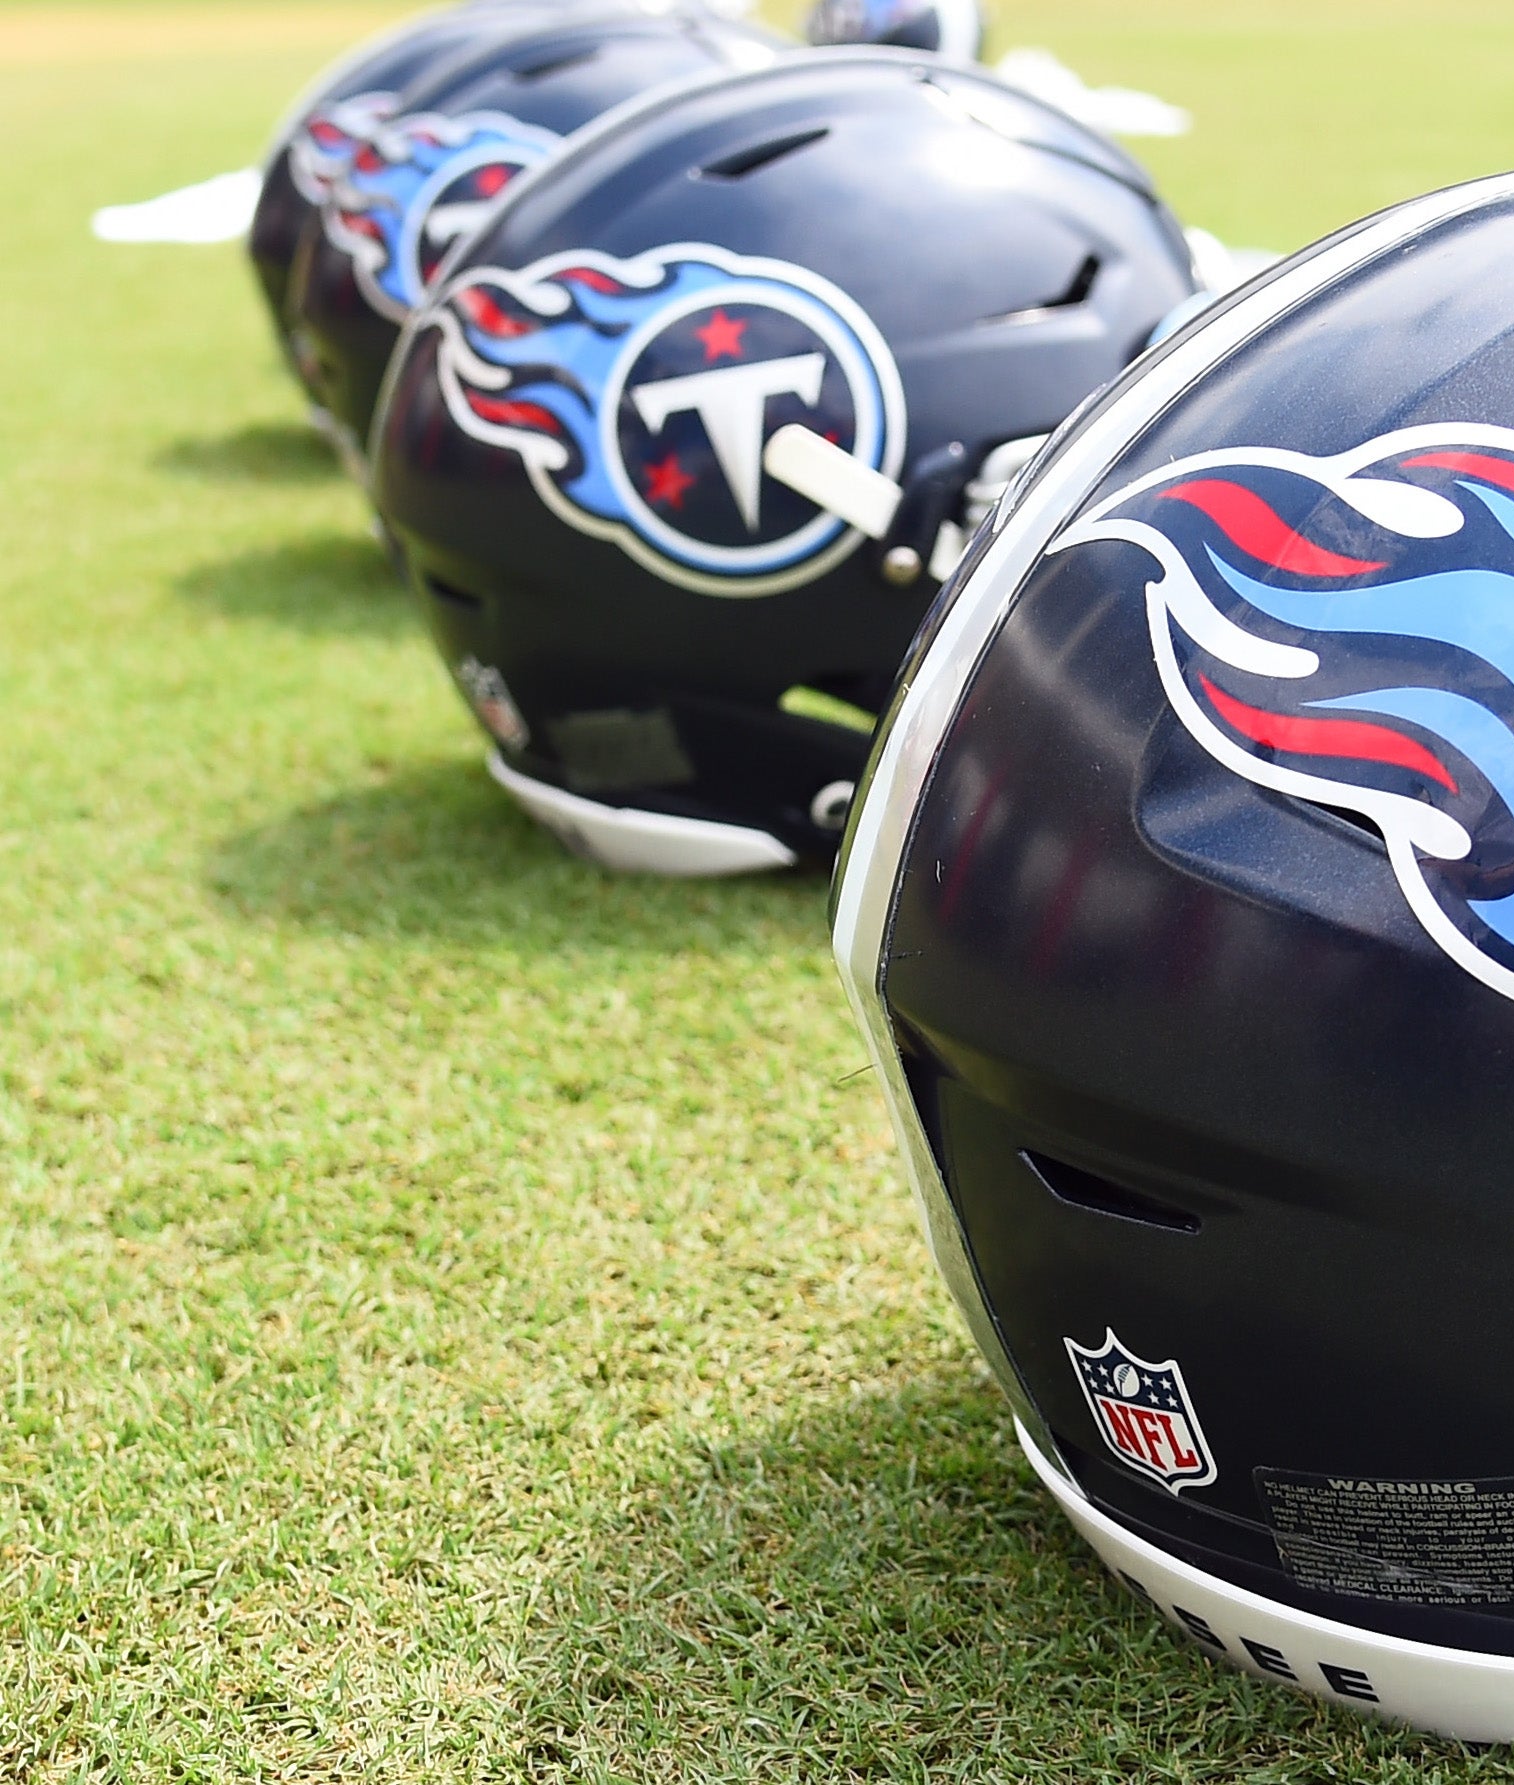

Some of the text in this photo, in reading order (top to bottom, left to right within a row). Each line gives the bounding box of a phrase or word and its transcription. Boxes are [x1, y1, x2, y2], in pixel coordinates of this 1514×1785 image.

[631, 352, 826, 532] T
[1101, 1400, 1199, 1471] NFL
[1264, 1481, 1278, 1490] NO
[1279, 1484, 1315, 1495] HELMET
[1317, 1489, 1338, 1498] CAN
[1339, 1491, 1382, 1501] PREVENT
[1384, 1495, 1428, 1503] SERIOUS
[1430, 1495, 1458, 1503] HEAD
[1477, 1493, 1506, 1501] NECK
[1327, 1479, 1476, 1494] WARNING
[1274, 1490, 1308, 1502] PLAYER
[1309, 1495, 1337, 1506] MIGHT
[1338, 1499, 1379, 1509] RECEIVE
[1380, 1502, 1410, 1510] WHILE
[1411, 1502, 1481, 1511] PARTICIPATING
[1483, 1502, 1494, 1510] IN
